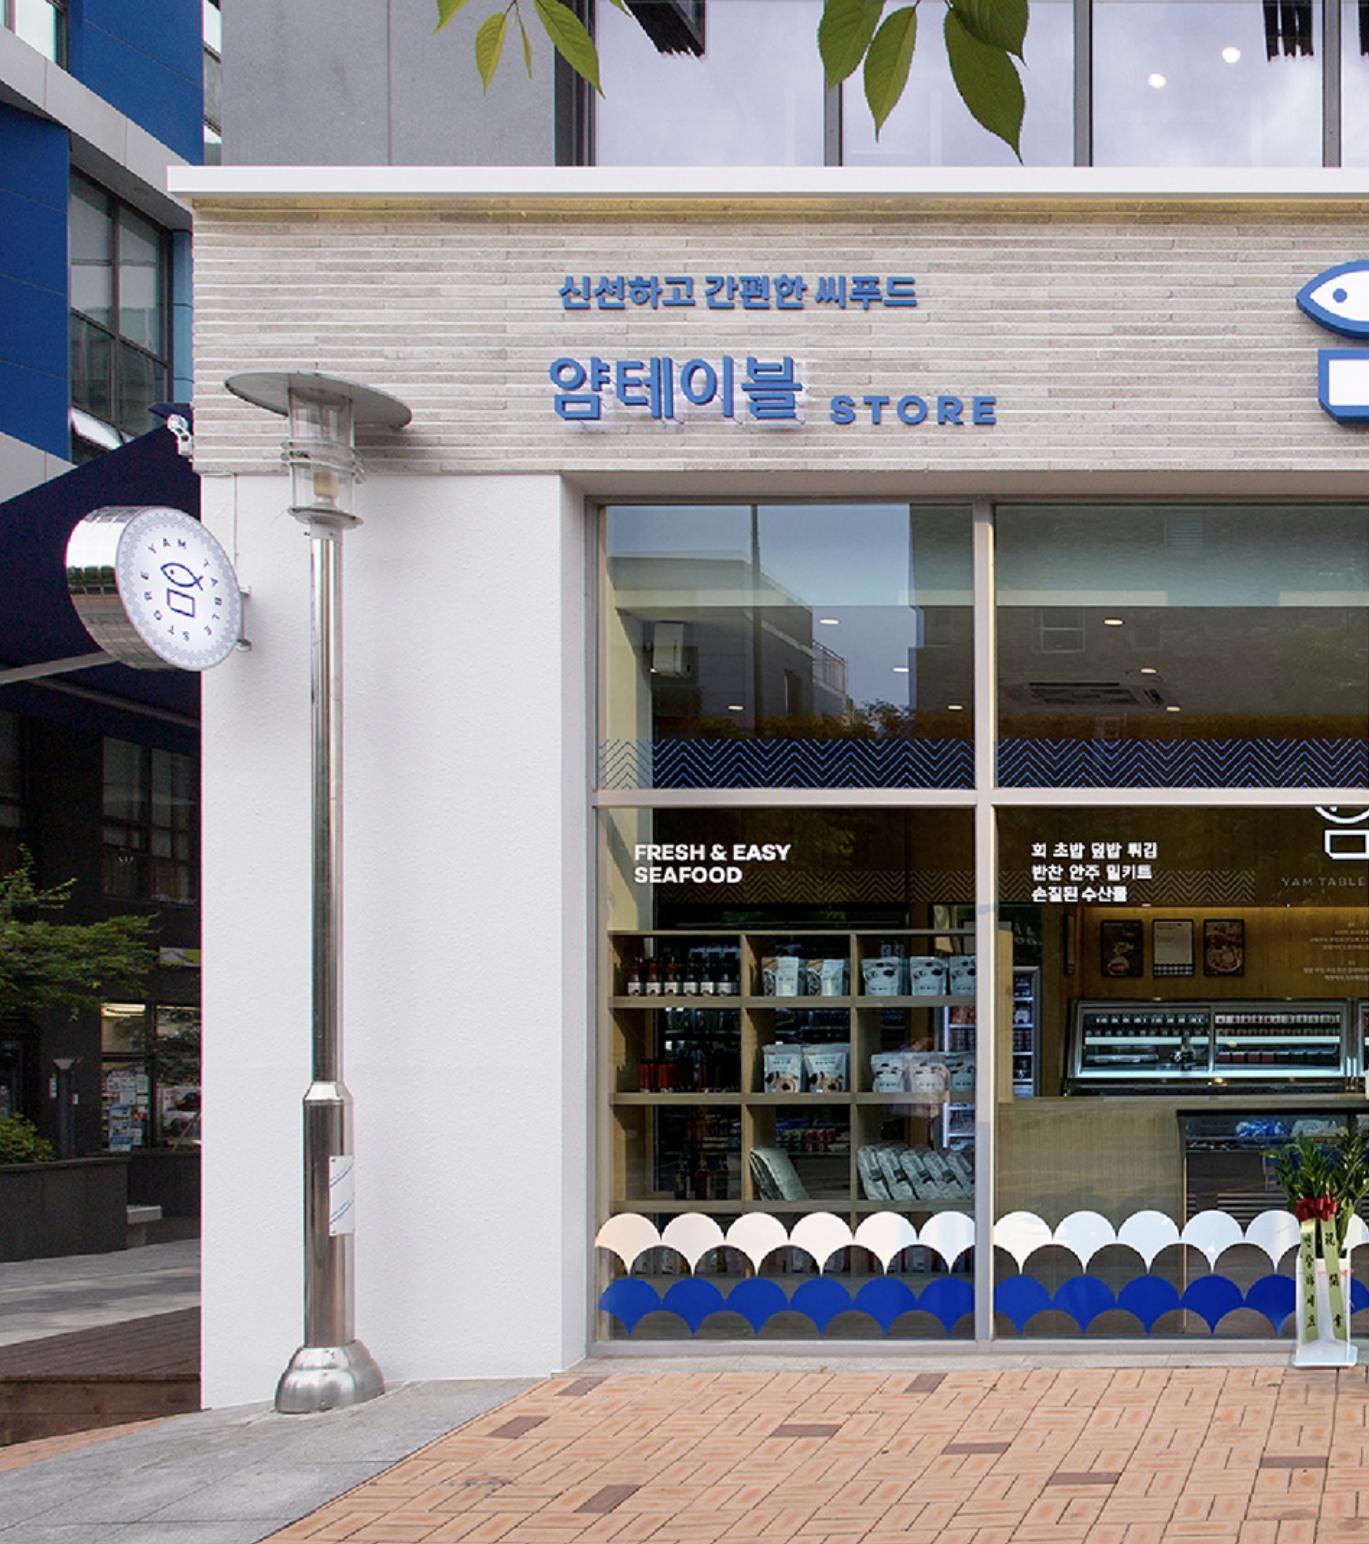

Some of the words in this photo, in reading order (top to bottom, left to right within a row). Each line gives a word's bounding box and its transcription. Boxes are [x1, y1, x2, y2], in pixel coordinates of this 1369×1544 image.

[558, 275, 696, 309] 신선하고
[704, 275, 807, 309] 간편한
[814, 275, 918, 308] 씨푸드
[549, 355, 804, 420] 얌테이블
[829, 394, 997, 425] STORE
[634, 844, 705, 861] FRESH
[710, 844, 727, 861] &
[733, 844, 791, 861] EASY
[1031, 842, 1047, 859] 회
[1053, 842, 1085, 859] 초밥
[1091, 842, 1122, 859] 덮밥
[1127, 842, 1158, 859] 튀김
[634, 866, 742, 884] SEAFOOD
[1032, 864, 1063, 881] 반찬
[1069, 864, 1100, 881] 안주
[1106, 864, 1153, 881] 밀키트
[1281, 877, 1313, 887] YAM
[1319, 877, 1366, 887] TABLE
[1031, 886, 1078, 902] 손질된
[1081, 886, 1127, 902] 수산물
